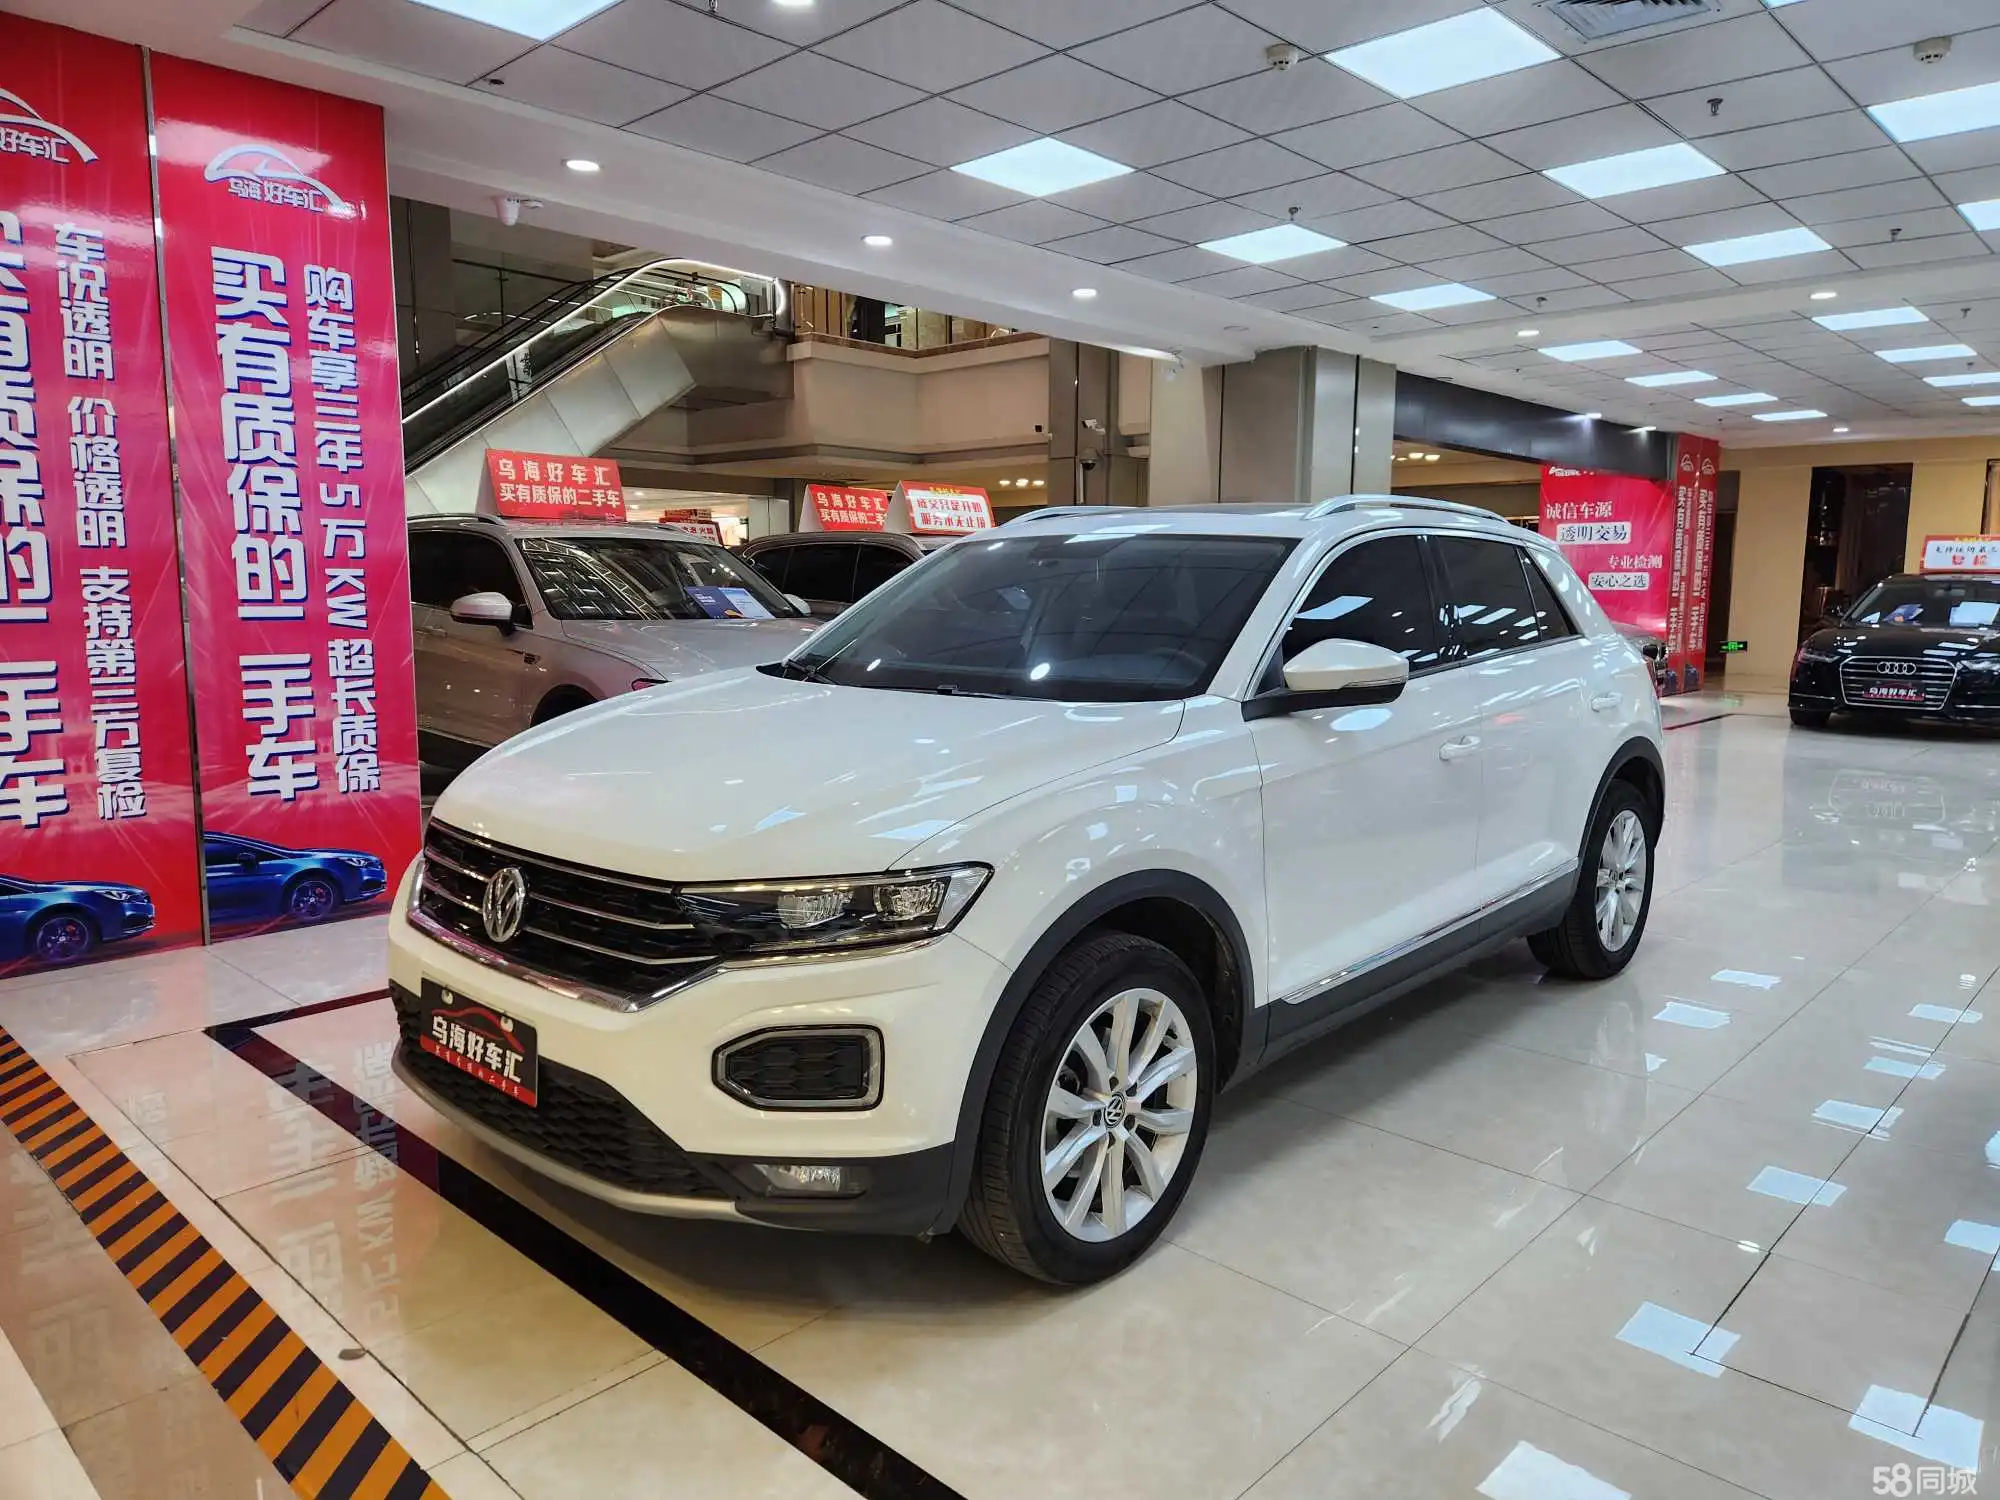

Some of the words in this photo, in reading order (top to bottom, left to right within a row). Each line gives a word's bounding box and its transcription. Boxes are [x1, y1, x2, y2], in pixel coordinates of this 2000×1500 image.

[54, 223, 114, 379] 车况透明
[67, 396, 126, 547] 价格透明
[499, 458, 611, 486] 乌海好车汇
[499, 483, 621, 508] 买有质保的二手车
[816, 492, 885, 512] 乌海好车汇
[820, 508, 888, 526] 买有质保的二手
[1546, 501, 1613, 519] 诚信车源
[211, 246, 318, 800] 买有质保的二手车
[1561, 525, 1627, 542] 透明交易
[1608, 554, 1663, 569] 专业检测
[1591, 574, 1647, 588] 安心之选
[79, 566, 146, 819] 支持第三方复检
[431, 1015, 524, 1083] 乌海好车汇
